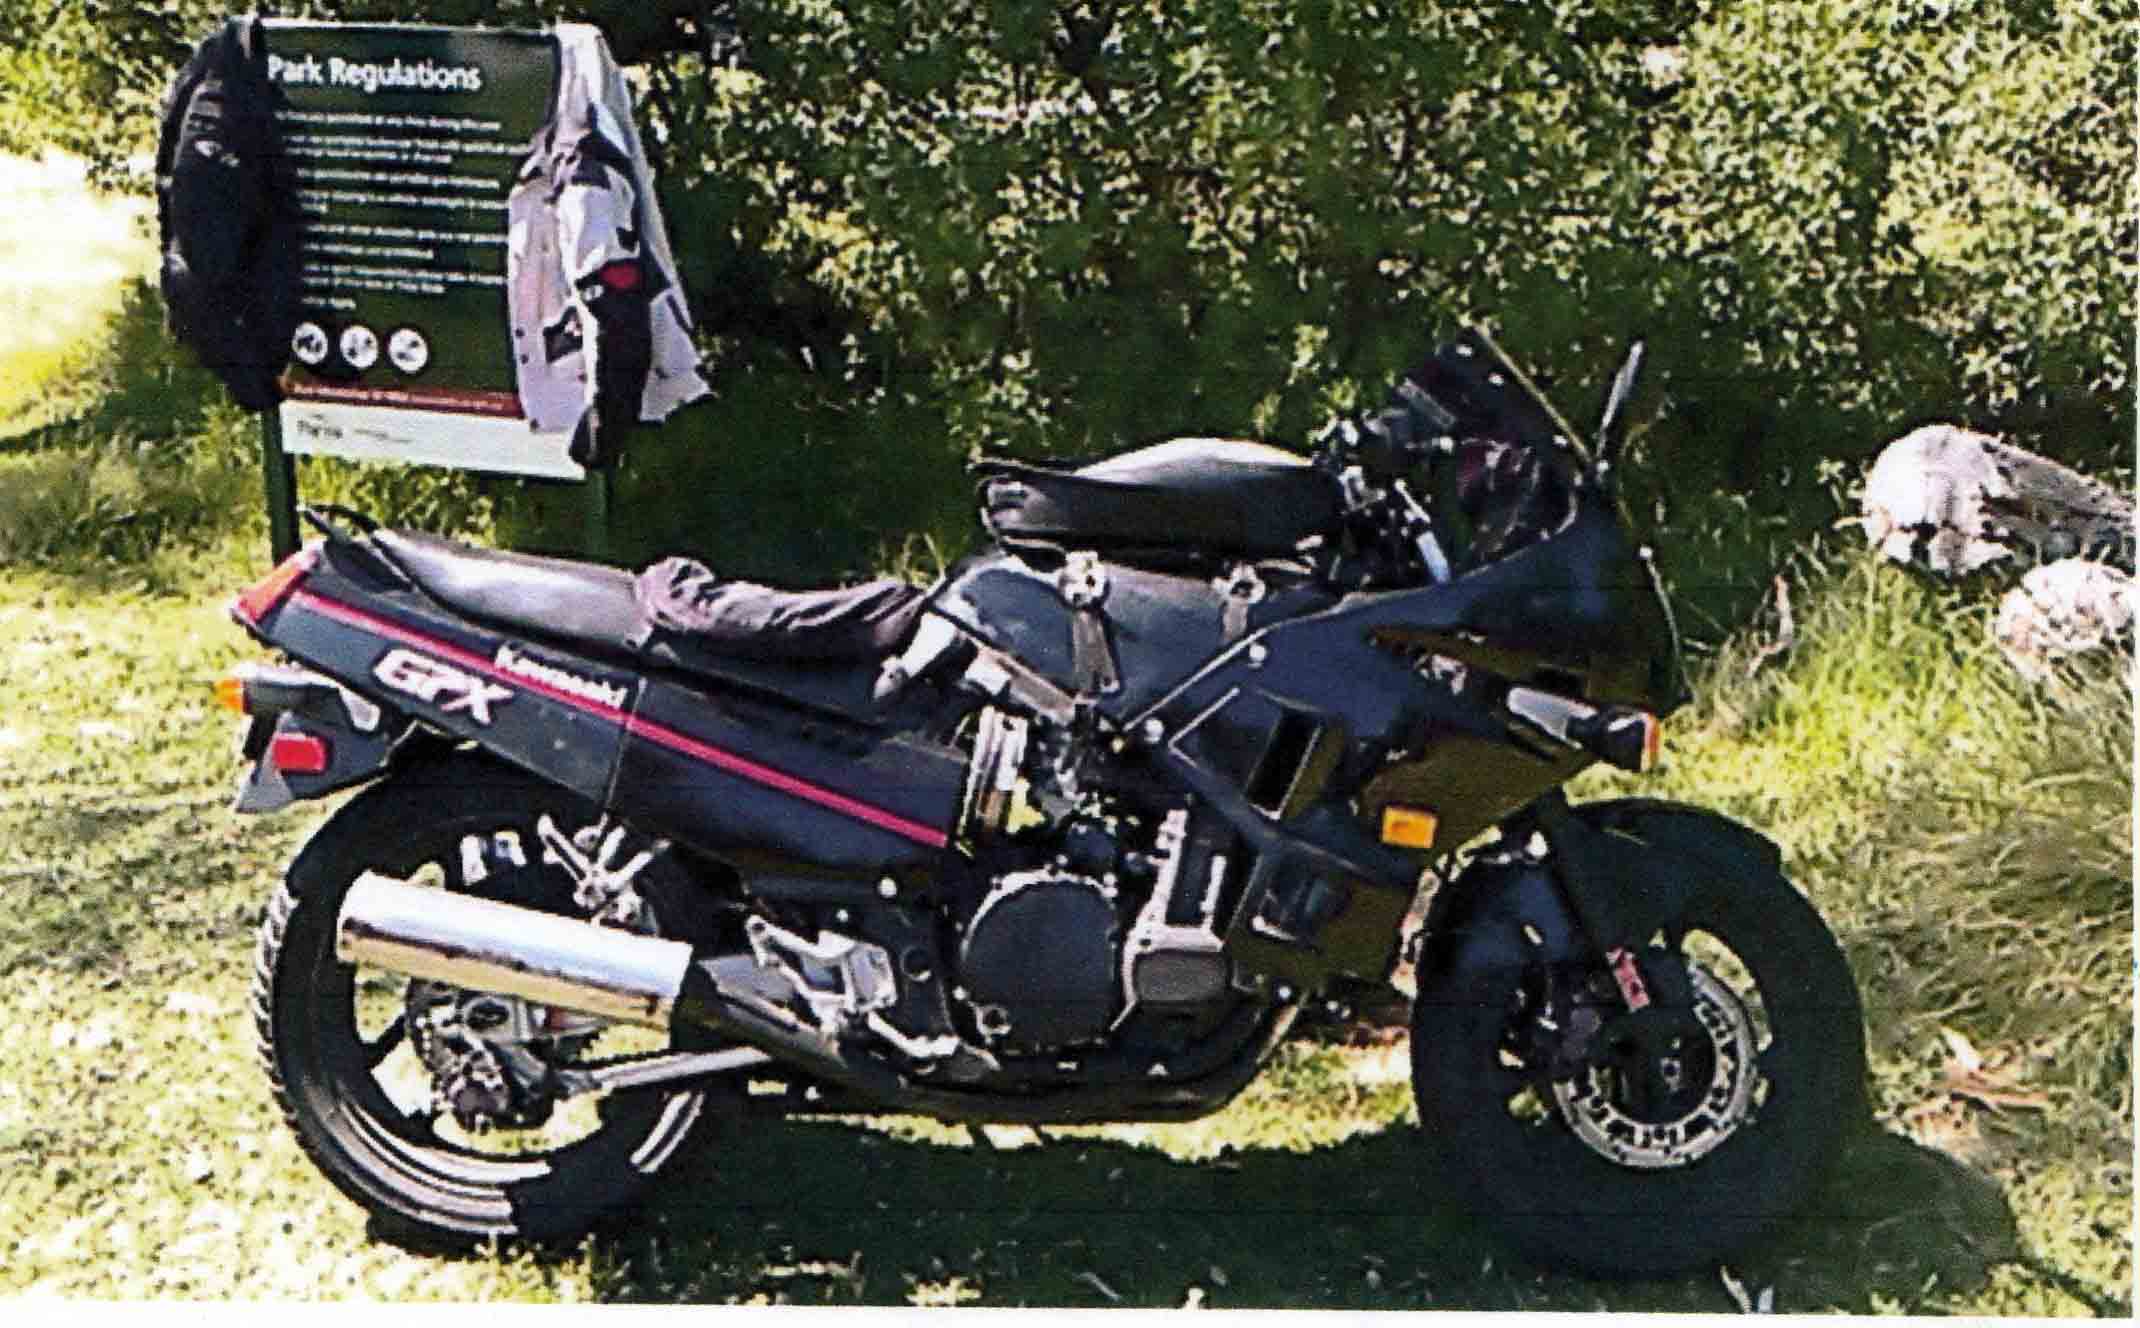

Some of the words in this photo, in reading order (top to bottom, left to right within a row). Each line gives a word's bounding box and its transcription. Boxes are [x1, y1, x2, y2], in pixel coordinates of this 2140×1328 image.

[267, 54, 324, 83] Park
[329, 57, 482, 93] Regulations
[372, 648, 514, 724] GPX
